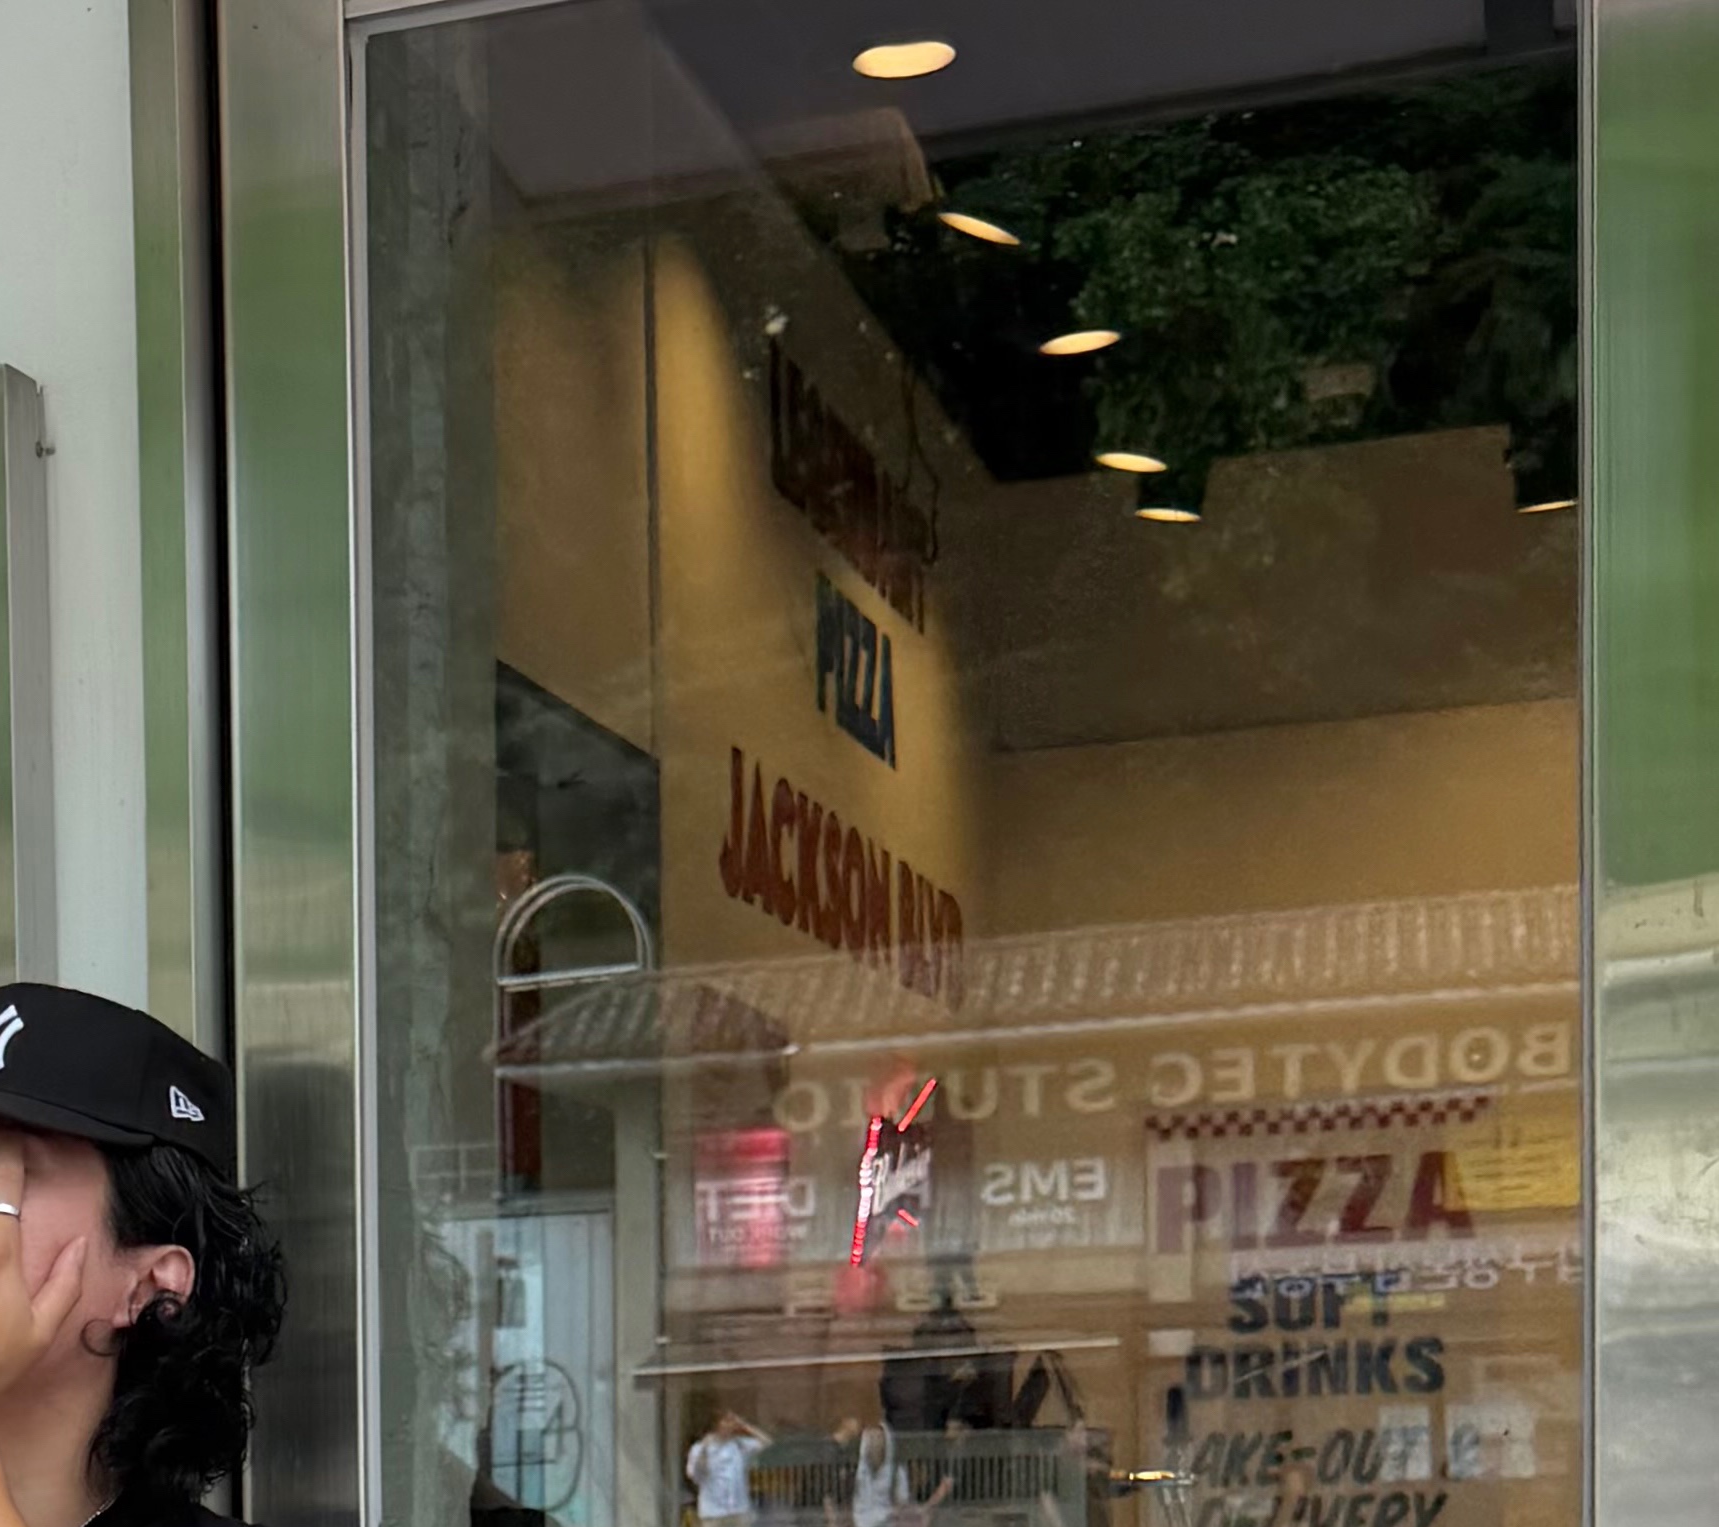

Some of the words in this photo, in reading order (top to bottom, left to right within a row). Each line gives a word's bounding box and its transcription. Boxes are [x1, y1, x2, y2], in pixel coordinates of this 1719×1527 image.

[719, 746, 892, 972] JACKSON
[1155, 1151, 1475, 1255] PIZZA
[1185, 1336, 1446, 1399] DRINKS
[1187, 1427, 1430, 1488] AKE-OUT
